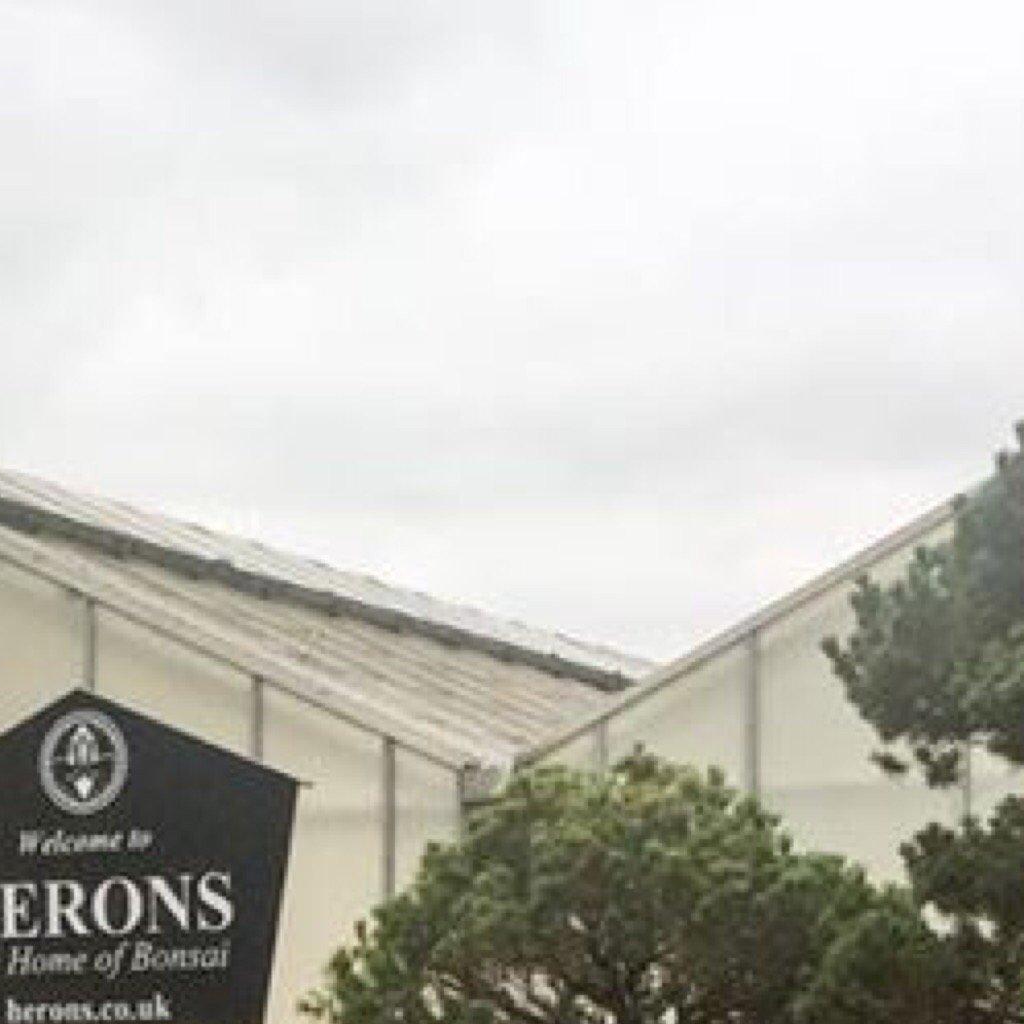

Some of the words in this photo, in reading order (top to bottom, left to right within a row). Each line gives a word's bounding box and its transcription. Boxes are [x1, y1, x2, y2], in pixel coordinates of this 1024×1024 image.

[18, 829, 123, 855] Welcome
[127, 829, 154, 854] to
[6, 944, 87, 976] Home
[95, 942, 128, 980] of
[130, 939, 231, 973] Bonsai
[6, 994, 171, 1023] herons.co.uk
